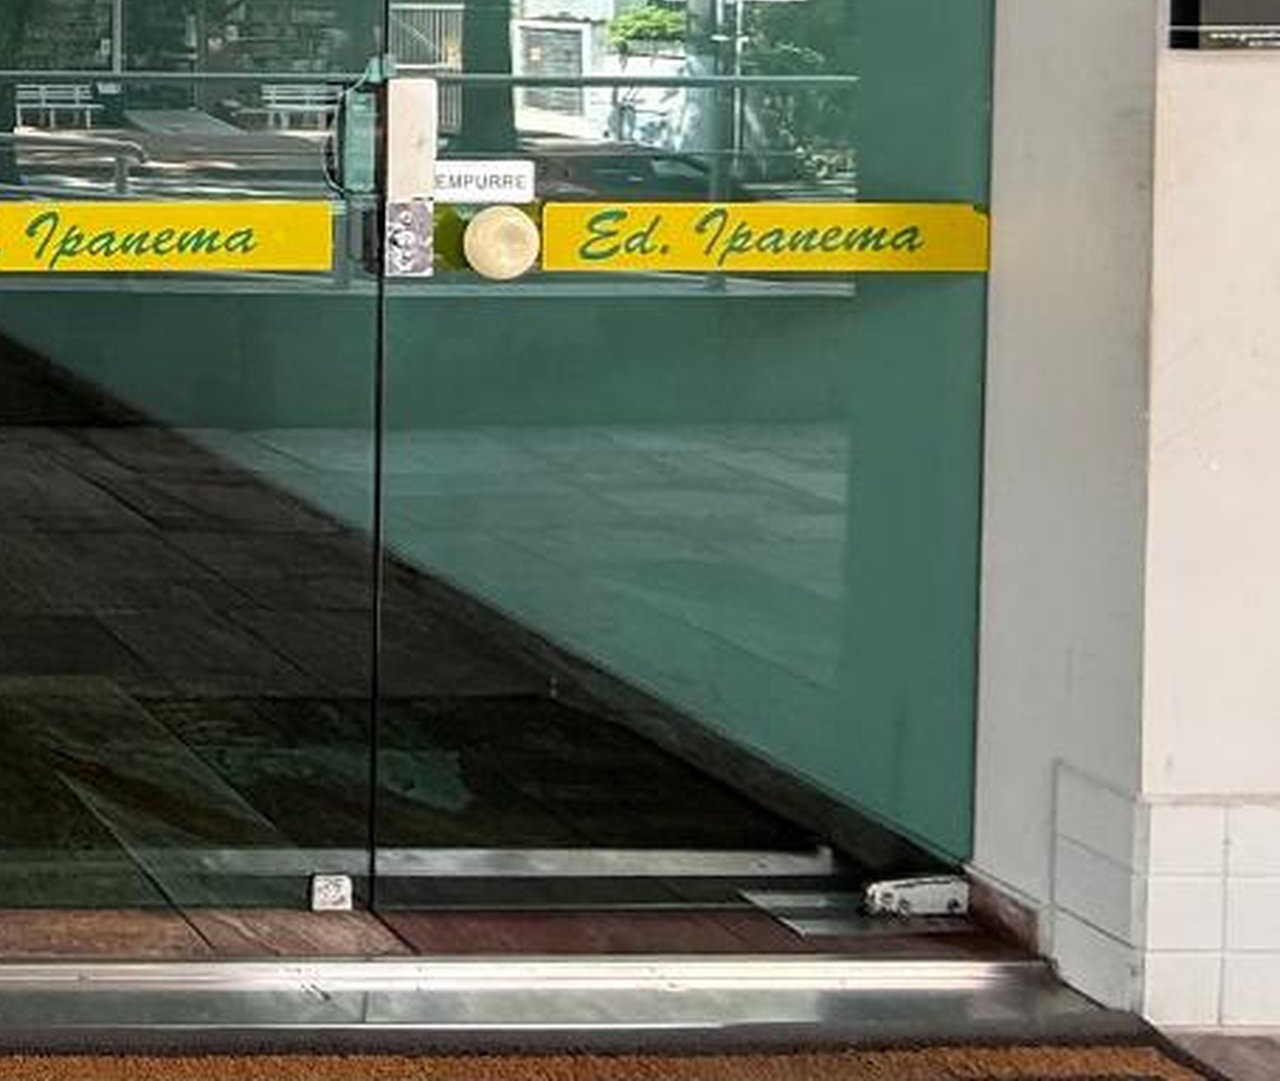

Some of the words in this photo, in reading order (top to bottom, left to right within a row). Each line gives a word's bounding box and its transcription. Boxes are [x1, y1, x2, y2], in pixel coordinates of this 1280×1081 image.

[434, 173, 526, 190] EMPURRE
[25, 210, 258, 269] Ipanema
[578, 209, 670, 261] Ed.
[694, 207, 926, 267] Ipanema
